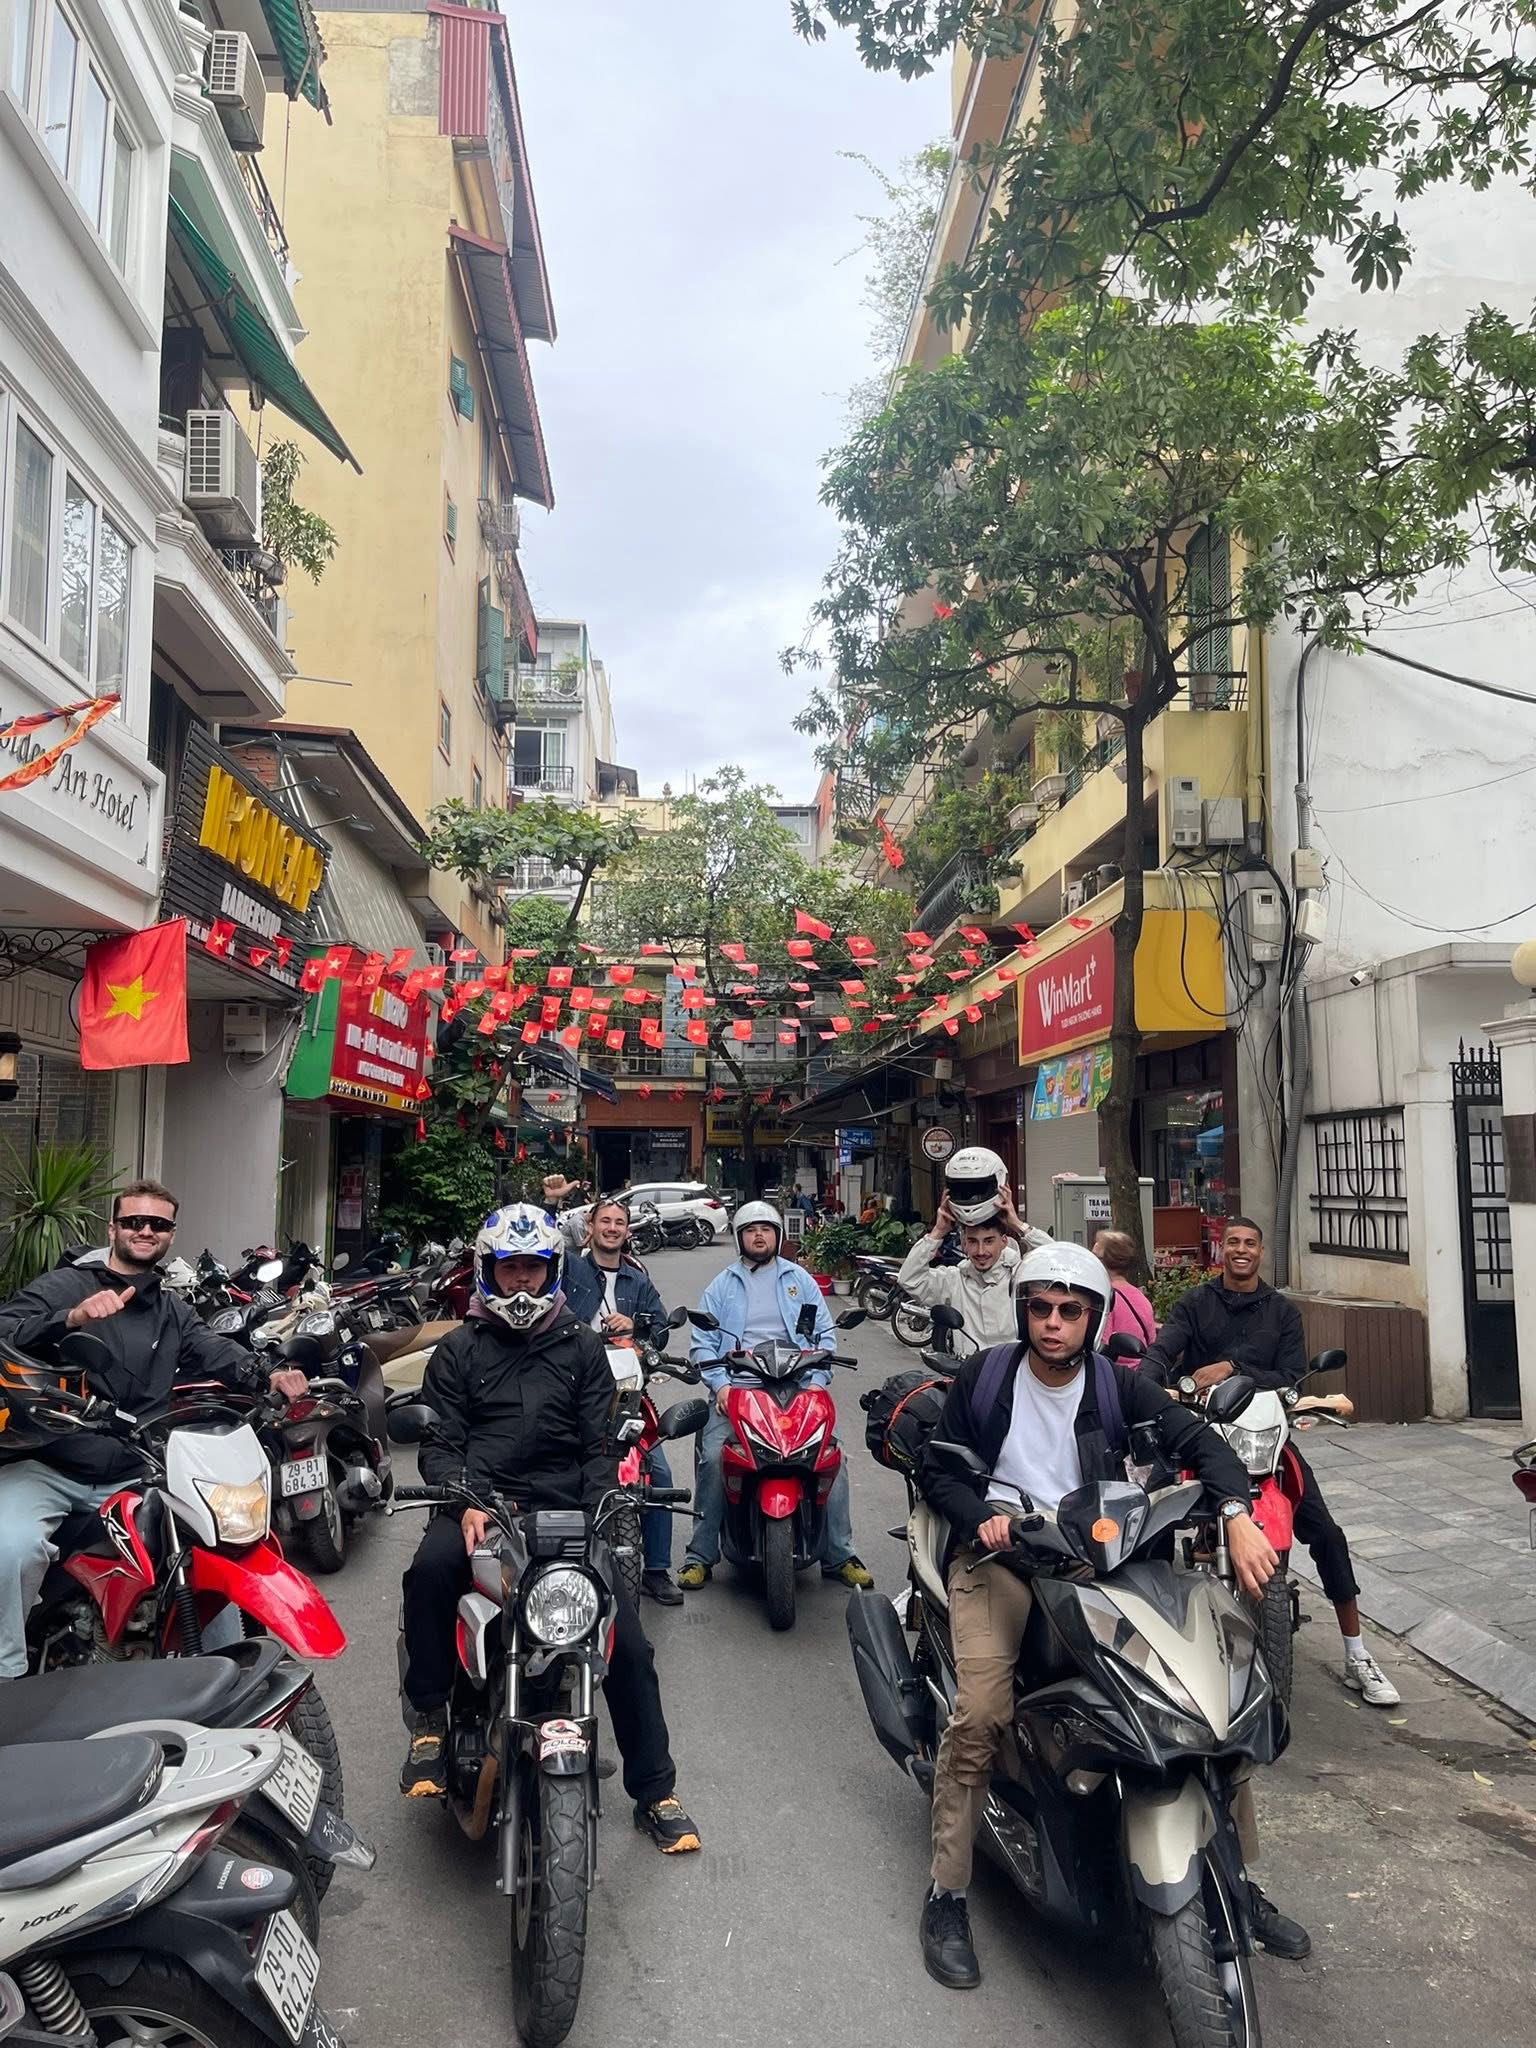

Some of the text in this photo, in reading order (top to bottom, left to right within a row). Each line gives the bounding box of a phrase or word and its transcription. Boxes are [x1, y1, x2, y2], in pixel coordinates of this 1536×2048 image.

[53, 753, 88, 801] Art
[90, 773, 137, 831] Hotel
[199, 765, 324, 914] IRONCAP
[220, 881, 282, 940] BARBERSHOP
[285, 1472, 324, 1493] 684.31
[288, 1459, 319, 1478] 29-B1
[288, 1754, 320, 1826] 007.43
[216, 1860, 235, 1890] HONDA
[263, 1915, 297, 1995] 29-D1
[281, 1938, 317, 2033] 842.07
